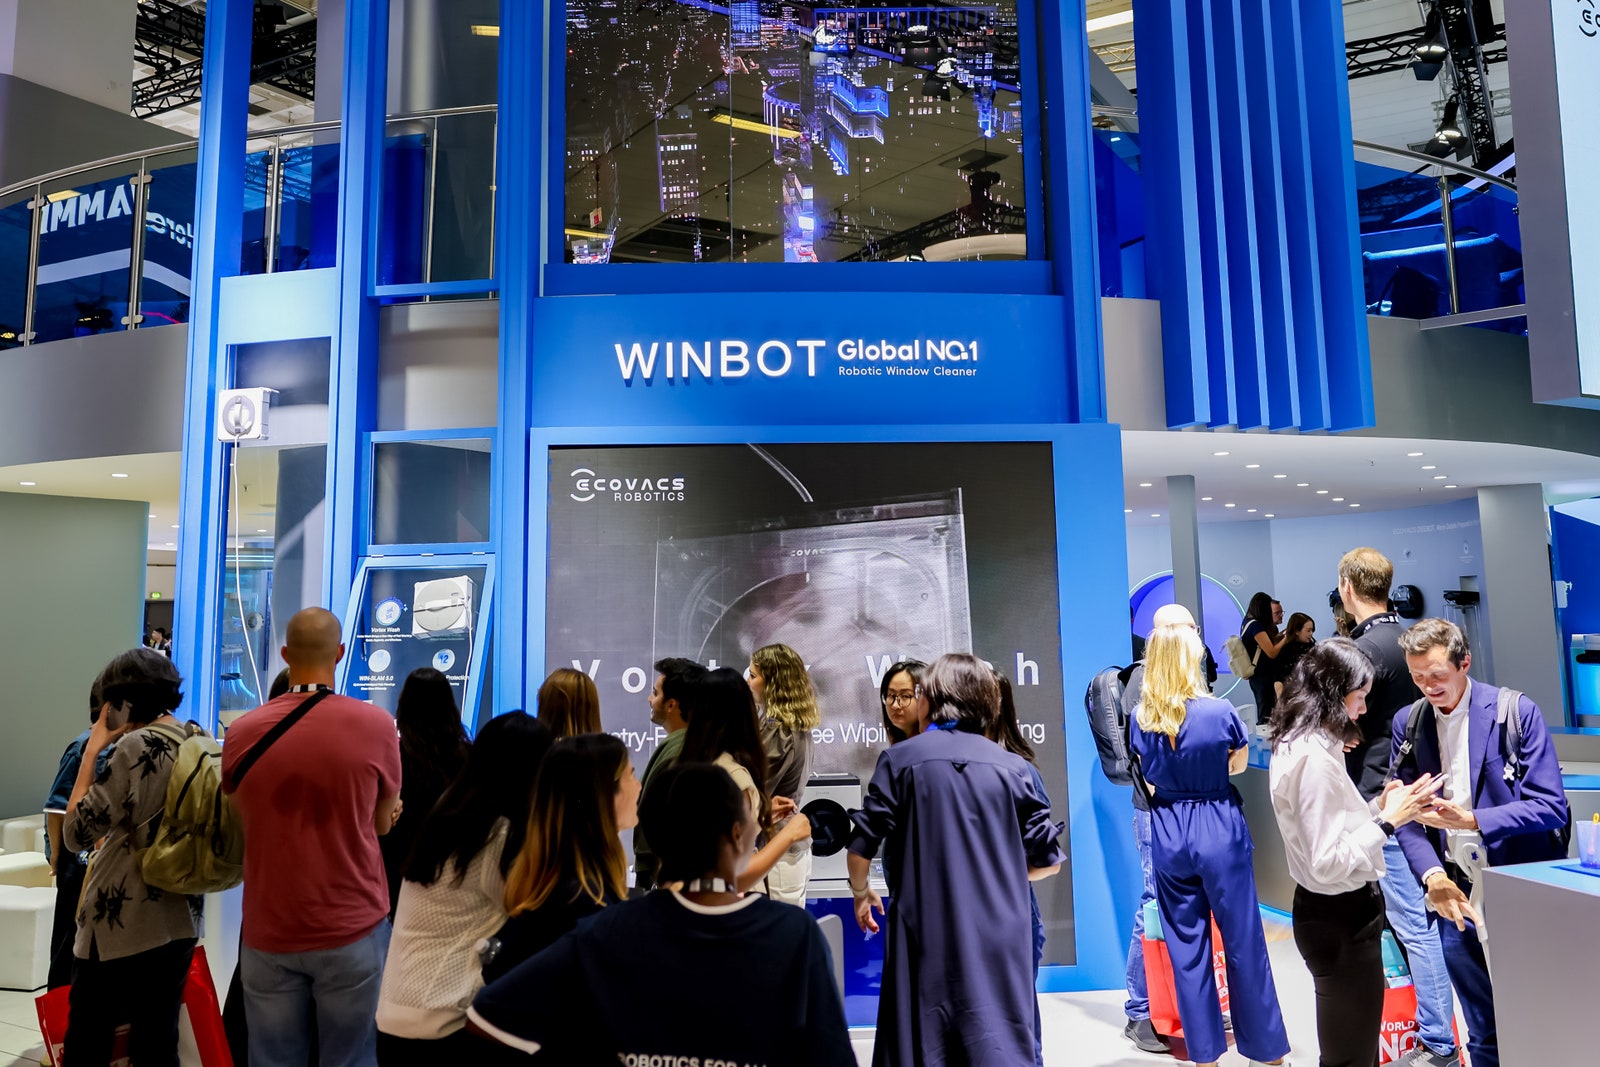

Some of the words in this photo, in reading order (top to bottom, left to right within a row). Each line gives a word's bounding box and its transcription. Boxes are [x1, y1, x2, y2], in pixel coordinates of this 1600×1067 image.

[614, 339, 826, 380] WINBOT
[837, 338, 920, 361] Global
[838, 366, 883, 376] Robotic
[885, 366, 930, 376] Window
[933, 366, 977, 377] Cleaner
[575, 478, 686, 491] ECOVACS
[614, 492, 685, 502] ROBOTICS
